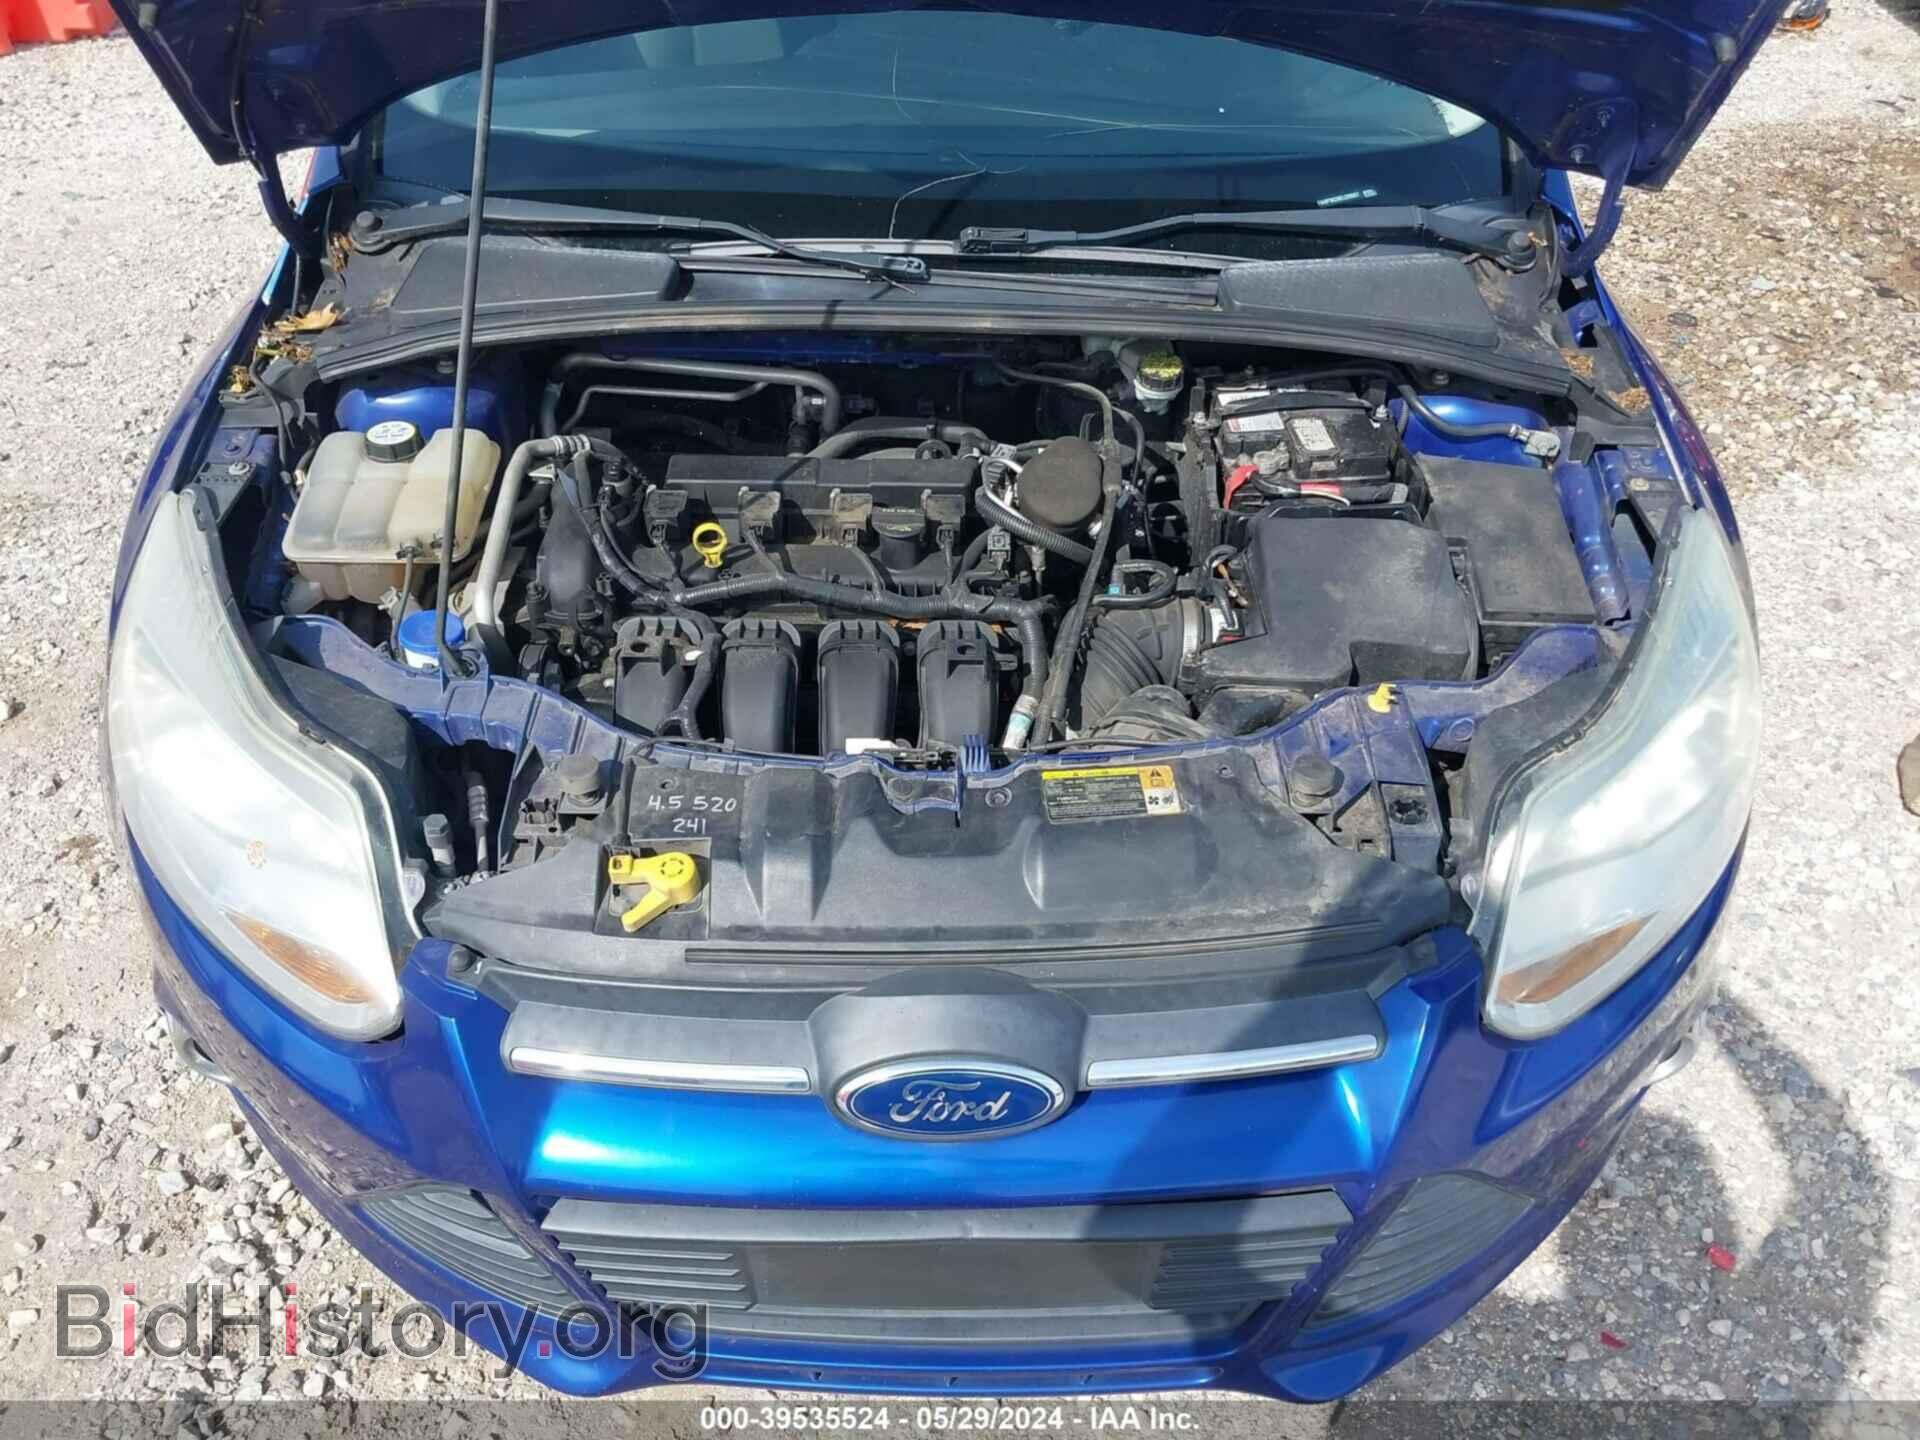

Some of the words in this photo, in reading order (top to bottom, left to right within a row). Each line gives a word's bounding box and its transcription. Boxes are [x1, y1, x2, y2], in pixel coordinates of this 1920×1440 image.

[692, 795, 737, 812] 520
[672, 818, 707, 834] 241
[888, 1079, 1011, 1123] Ford
